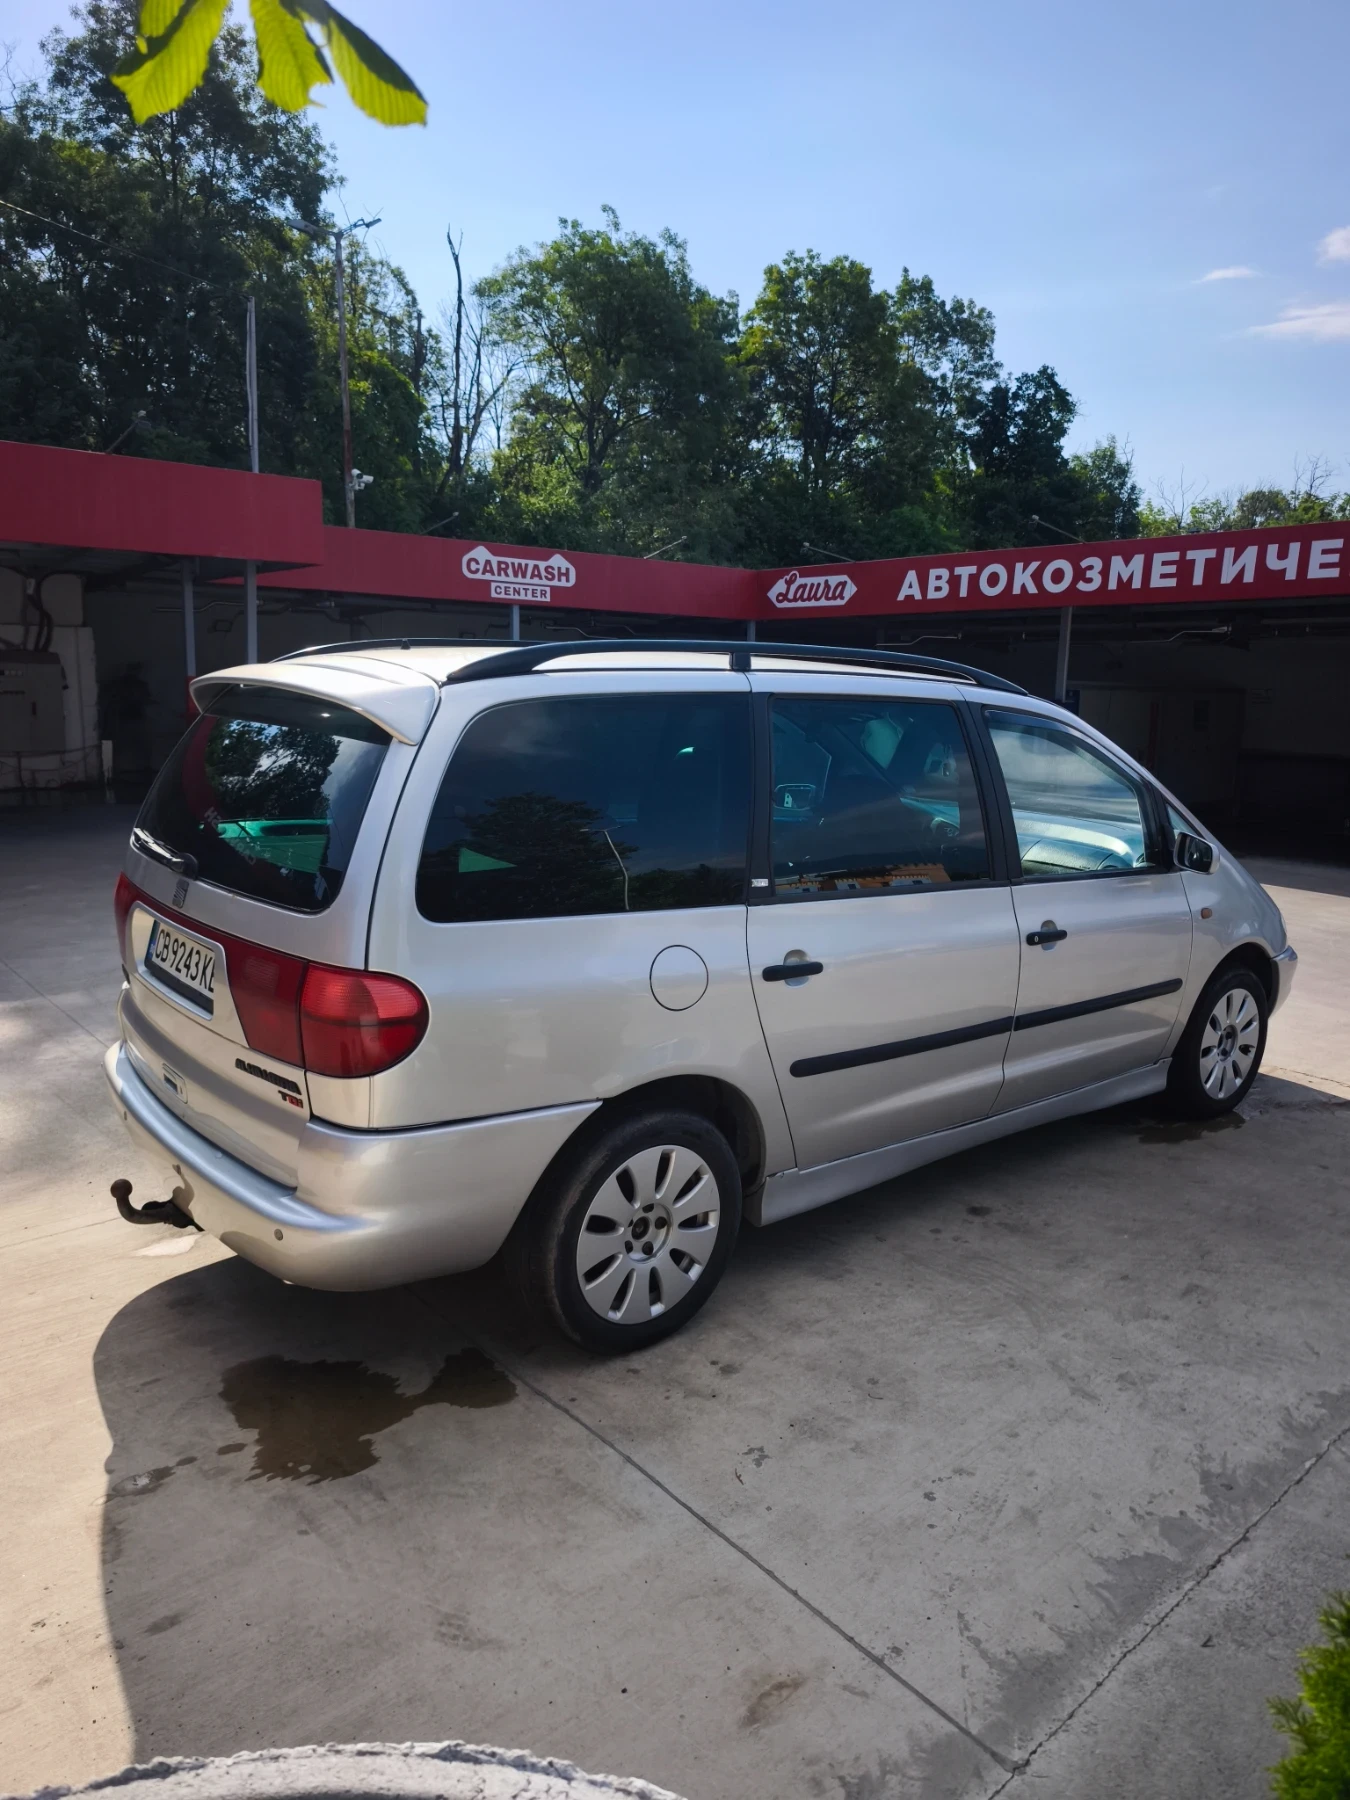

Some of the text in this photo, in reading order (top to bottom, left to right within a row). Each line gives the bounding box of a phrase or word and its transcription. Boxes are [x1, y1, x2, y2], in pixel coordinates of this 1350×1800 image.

[465, 556, 571, 584] CARWASH
[896, 538, 1350, 601] АВТОКОЗМЕТИЧЕ
[494, 585, 549, 600] CENTER
[776, 572, 848, 603] Laura
